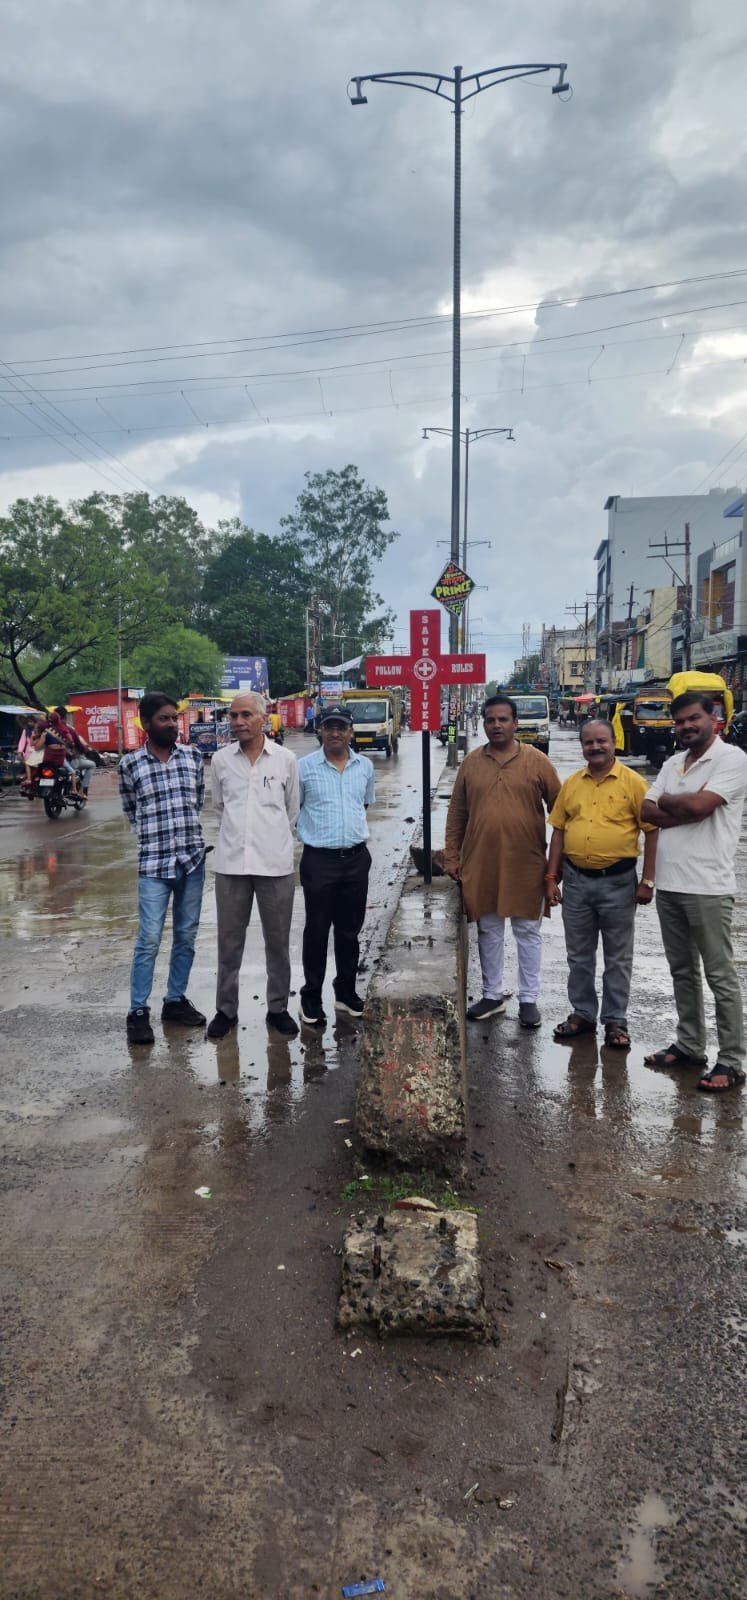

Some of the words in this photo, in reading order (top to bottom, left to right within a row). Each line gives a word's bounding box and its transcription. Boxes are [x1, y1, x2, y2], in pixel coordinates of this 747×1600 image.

[435, 580, 471, 598] PRINCE
[421, 615, 429, 656] SAVE
[375, 665, 402, 676] FOLLOW
[451, 663, 474, 673] RULES
[421, 681, 429, 730] LIVES
